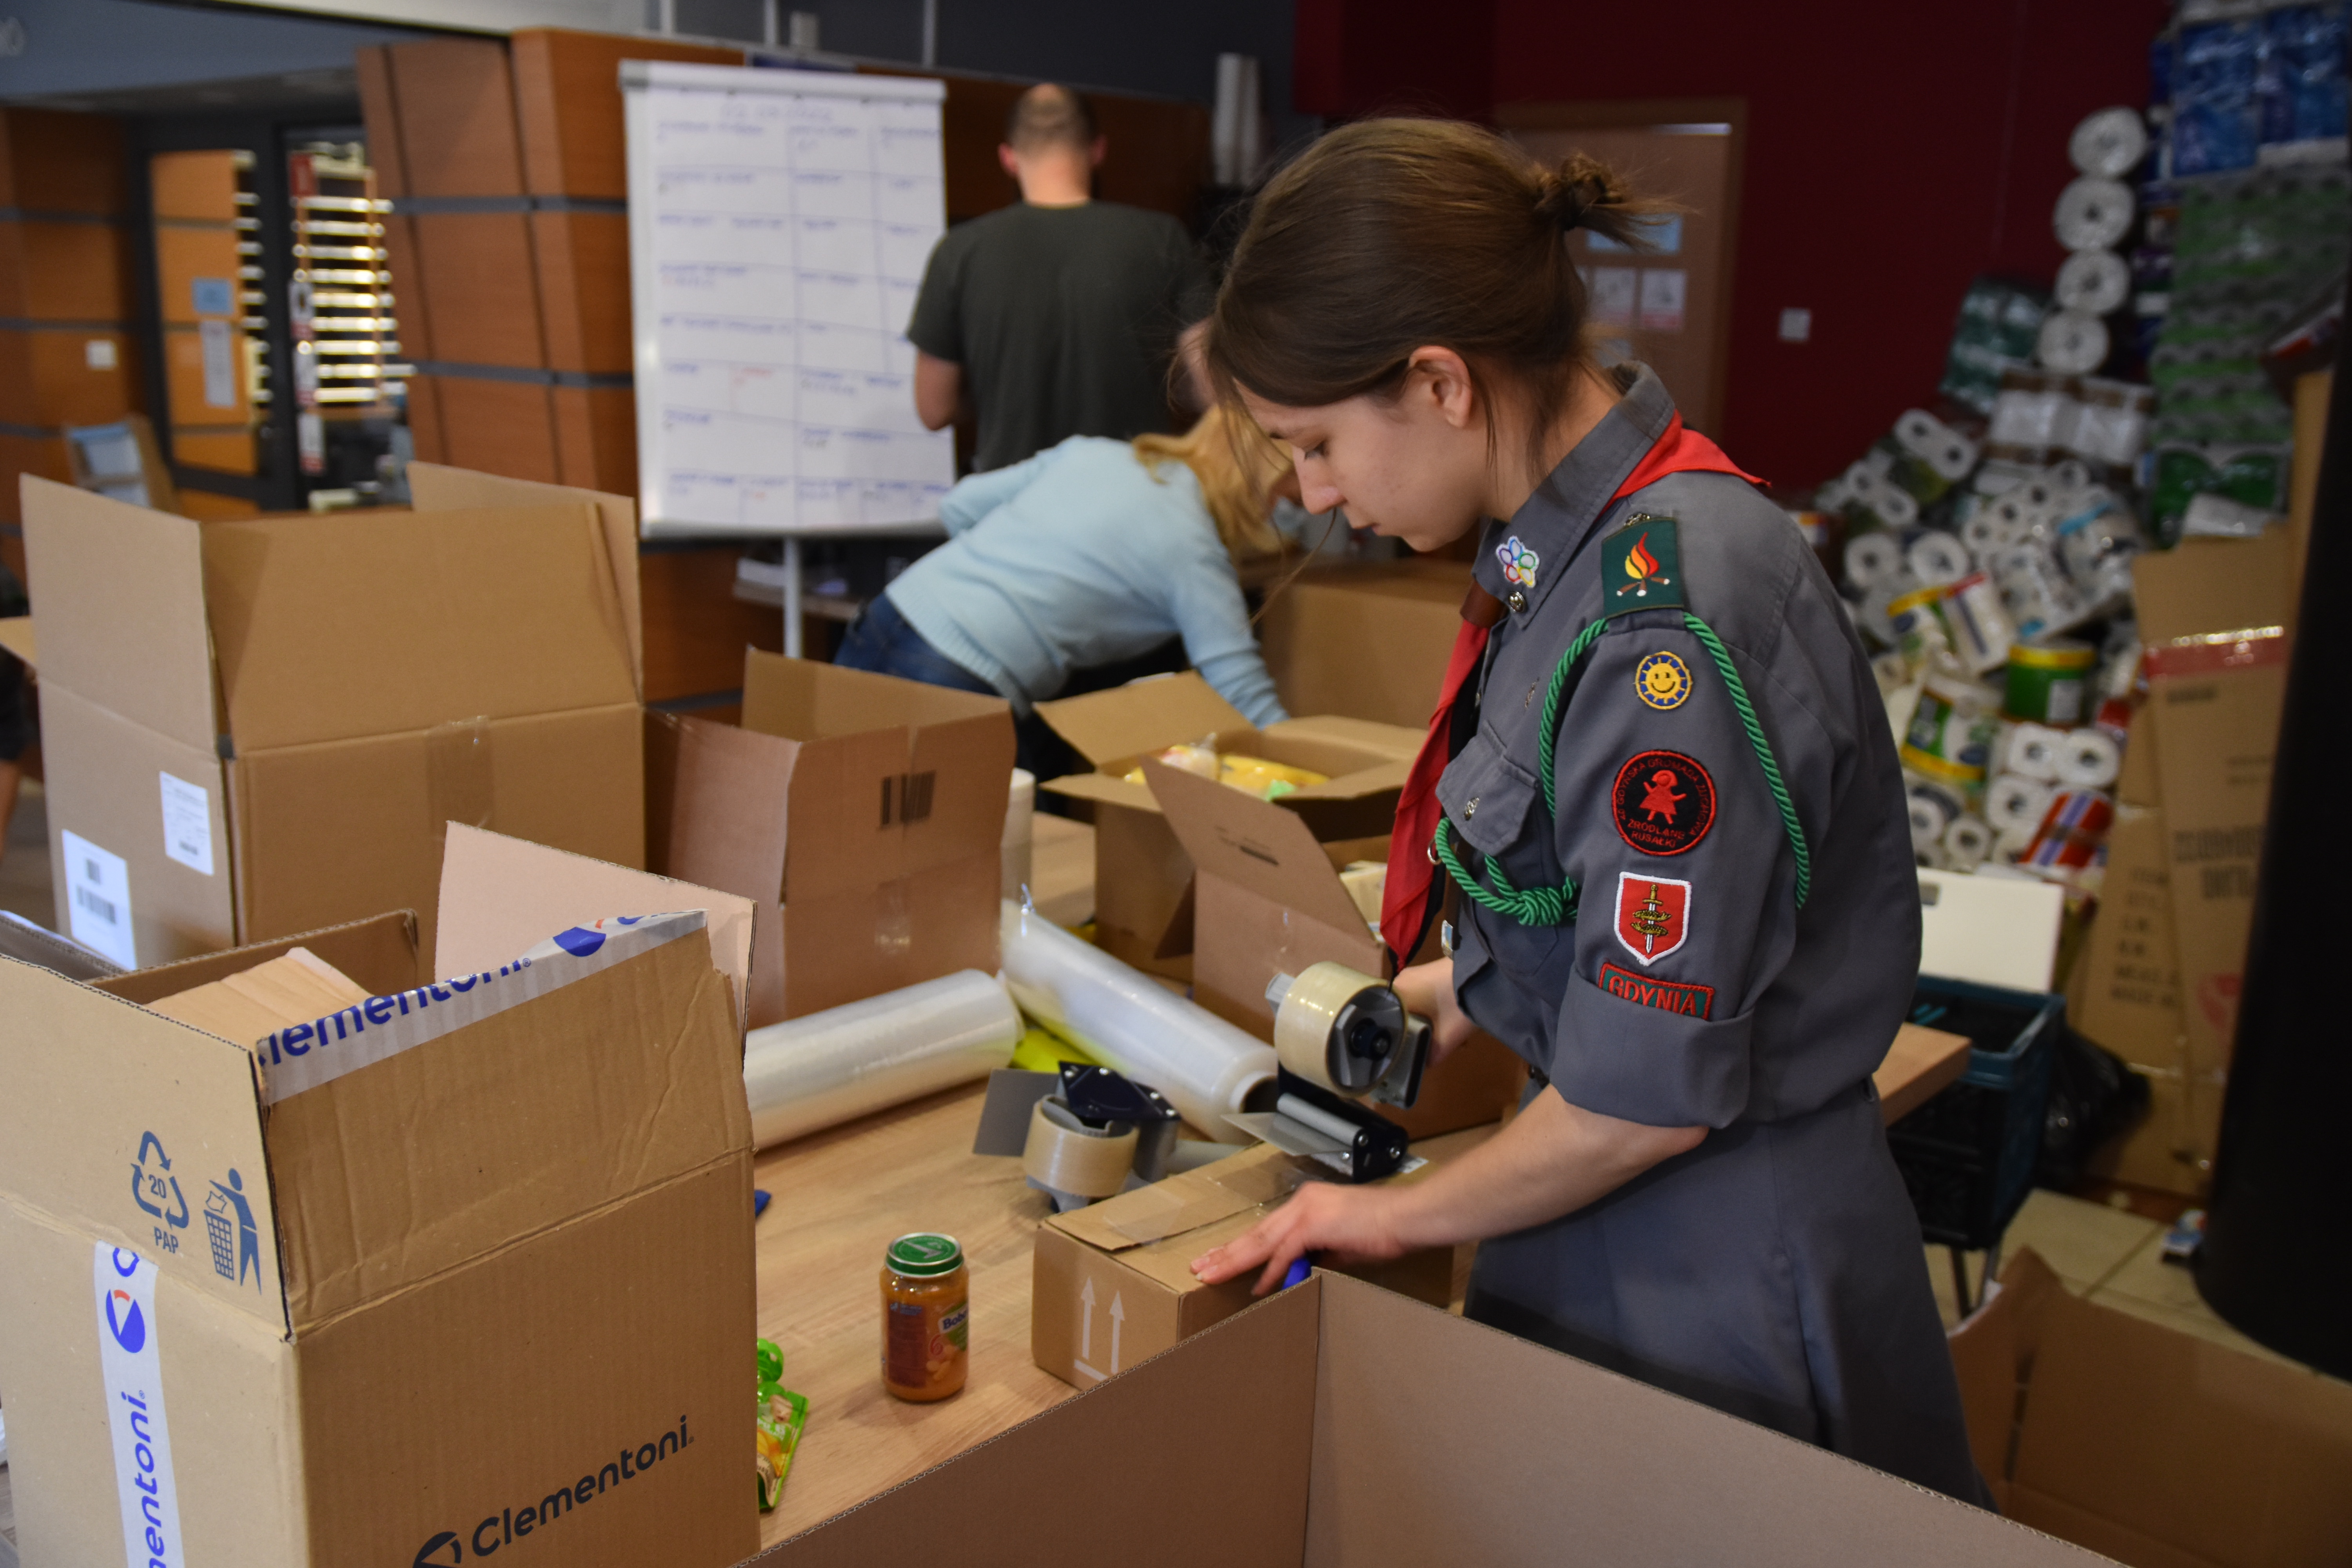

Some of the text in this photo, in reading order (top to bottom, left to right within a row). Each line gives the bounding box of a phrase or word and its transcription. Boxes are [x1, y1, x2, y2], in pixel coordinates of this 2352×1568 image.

[1648, 758, 1699, 782] GROMADA
[257, 959, 522, 1067] lemento
[1608, 975, 1697, 1016] GDYNIA
[148, 1174, 167, 1199] 20
[154, 1226, 179, 1254] PAP
[121, 1390, 167, 1568] entoni
[472, 1415, 688, 1557] Clementoni
